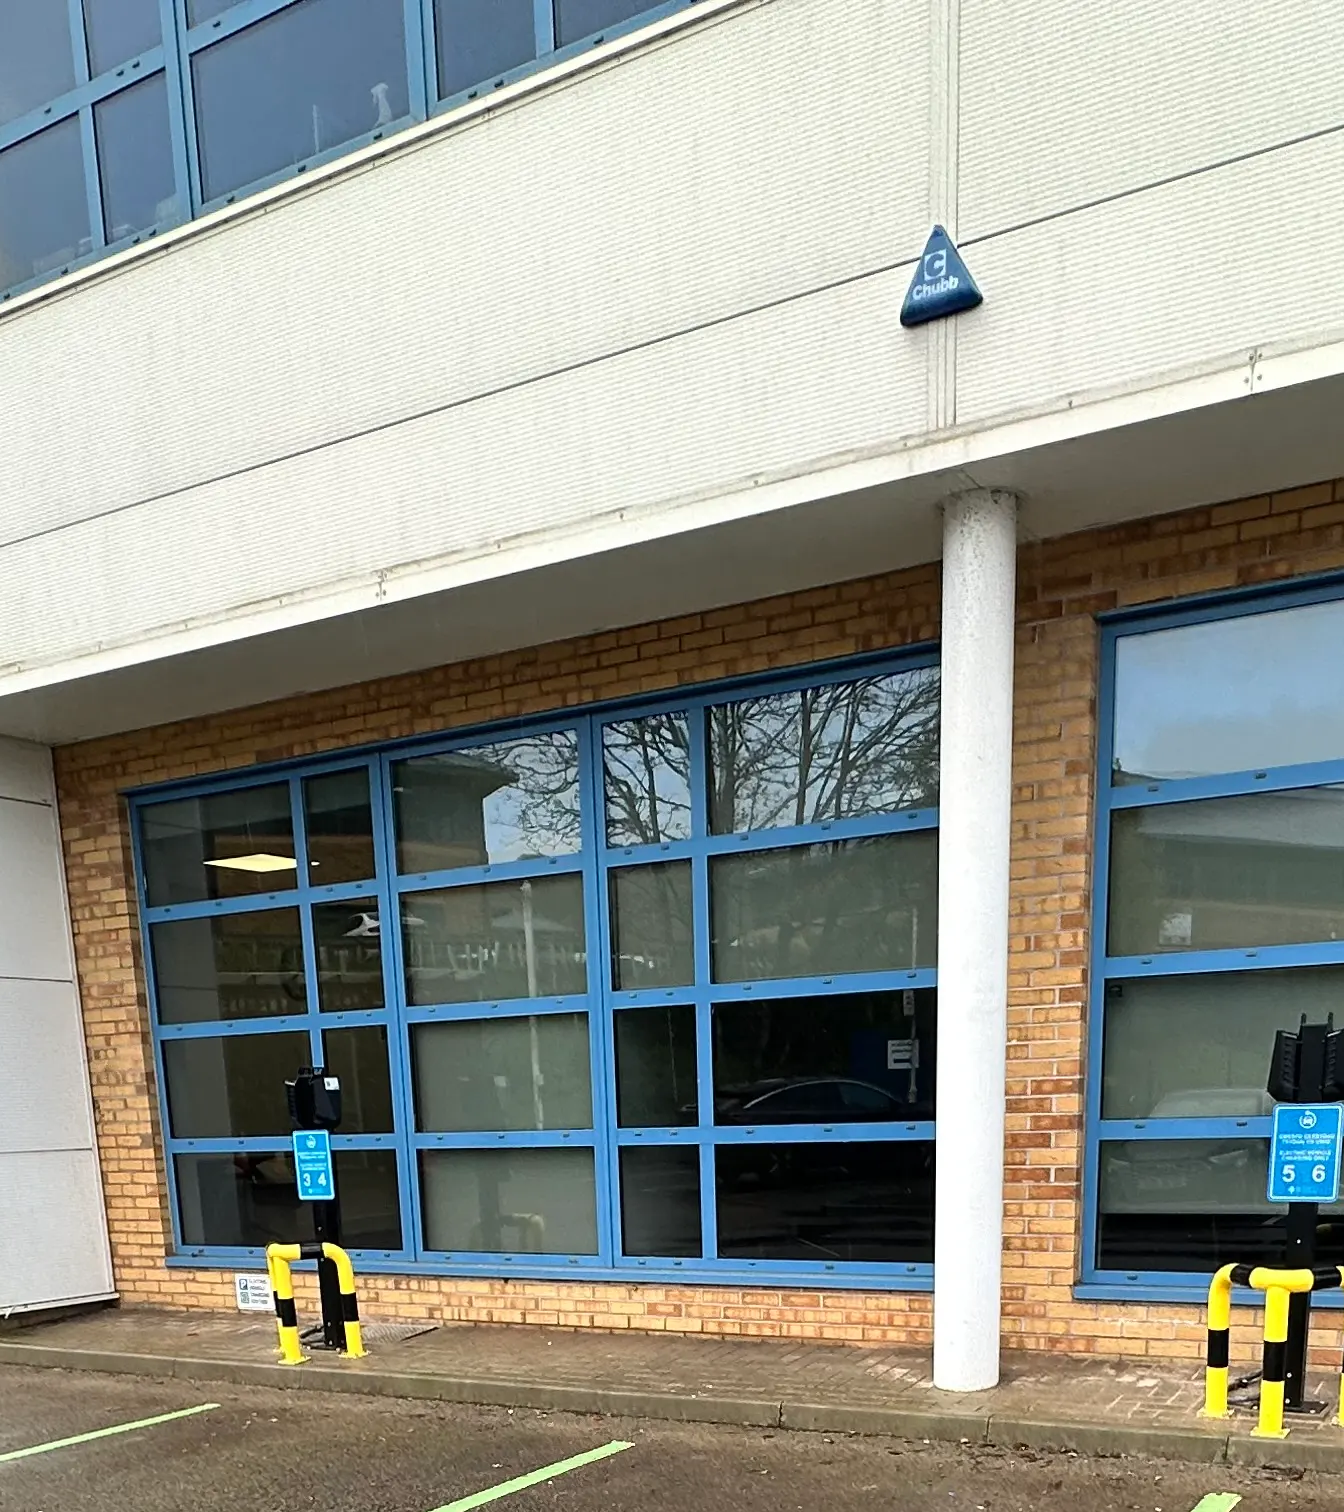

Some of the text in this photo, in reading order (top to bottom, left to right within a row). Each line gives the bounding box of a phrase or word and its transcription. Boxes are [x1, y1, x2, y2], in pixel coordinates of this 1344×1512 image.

[912, 275, 959, 300] Chubb
[303, 1172, 327, 1187] 3 4
[1282, 1164, 1326, 1183] 5 6
